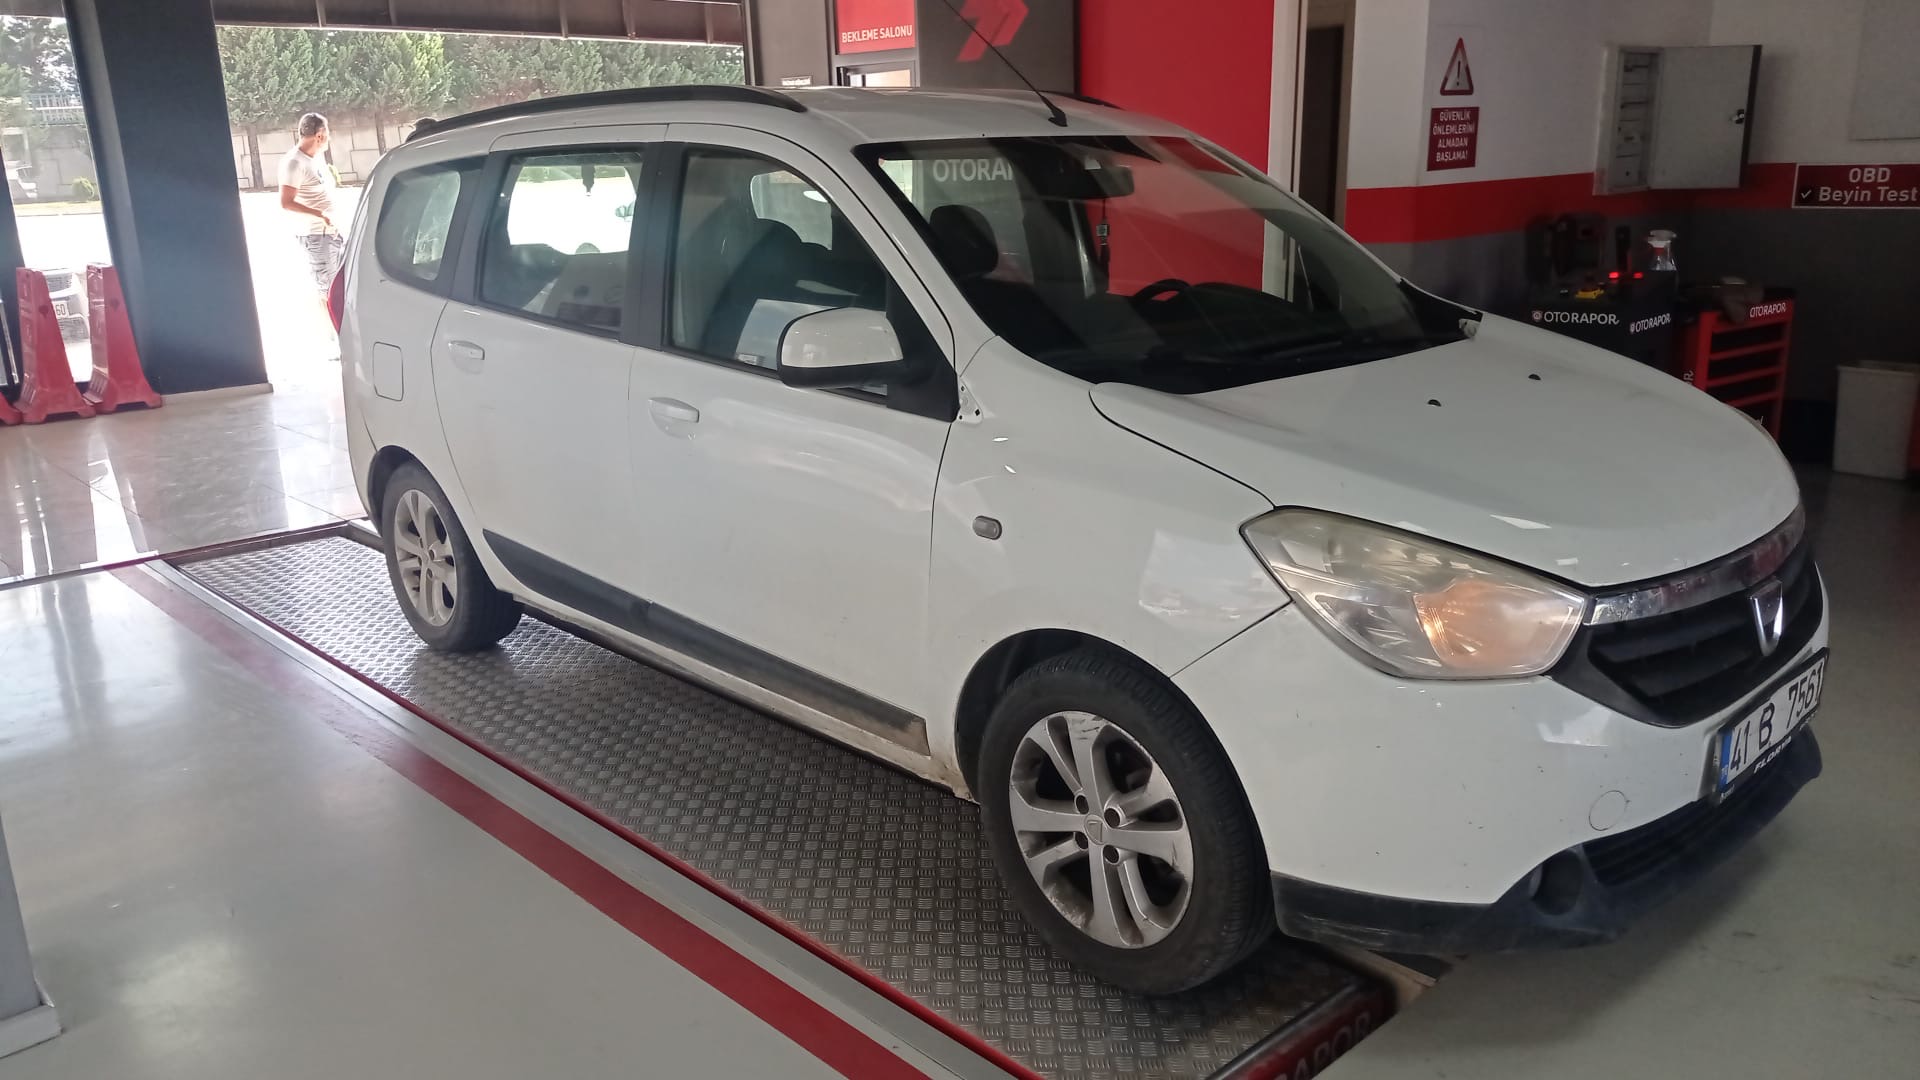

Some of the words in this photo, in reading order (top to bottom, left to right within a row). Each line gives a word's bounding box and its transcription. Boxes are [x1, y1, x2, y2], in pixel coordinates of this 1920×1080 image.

[841, 28, 879, 43] BEKLEME
[879, 25, 913, 38] SALONU
[1438, 136, 1468, 148] ALMADAN
[1436, 150, 1468, 162] BAŞLAMA!
[1848, 167, 1891, 183] OBD
[1818, 186, 1872, 205] Beyin
[1544, 311, 1619, 325] OTORAPOR
[1750, 302, 1786, 318] OTORAPOR
[1635, 312, 1671, 333] OTORAPOR
[1730, 721, 1750, 772] 41
[1759, 702, 1775, 751] B
[1786, 661, 1824, 730] 7561
[1275, 1011, 1372, 1080] APOR
